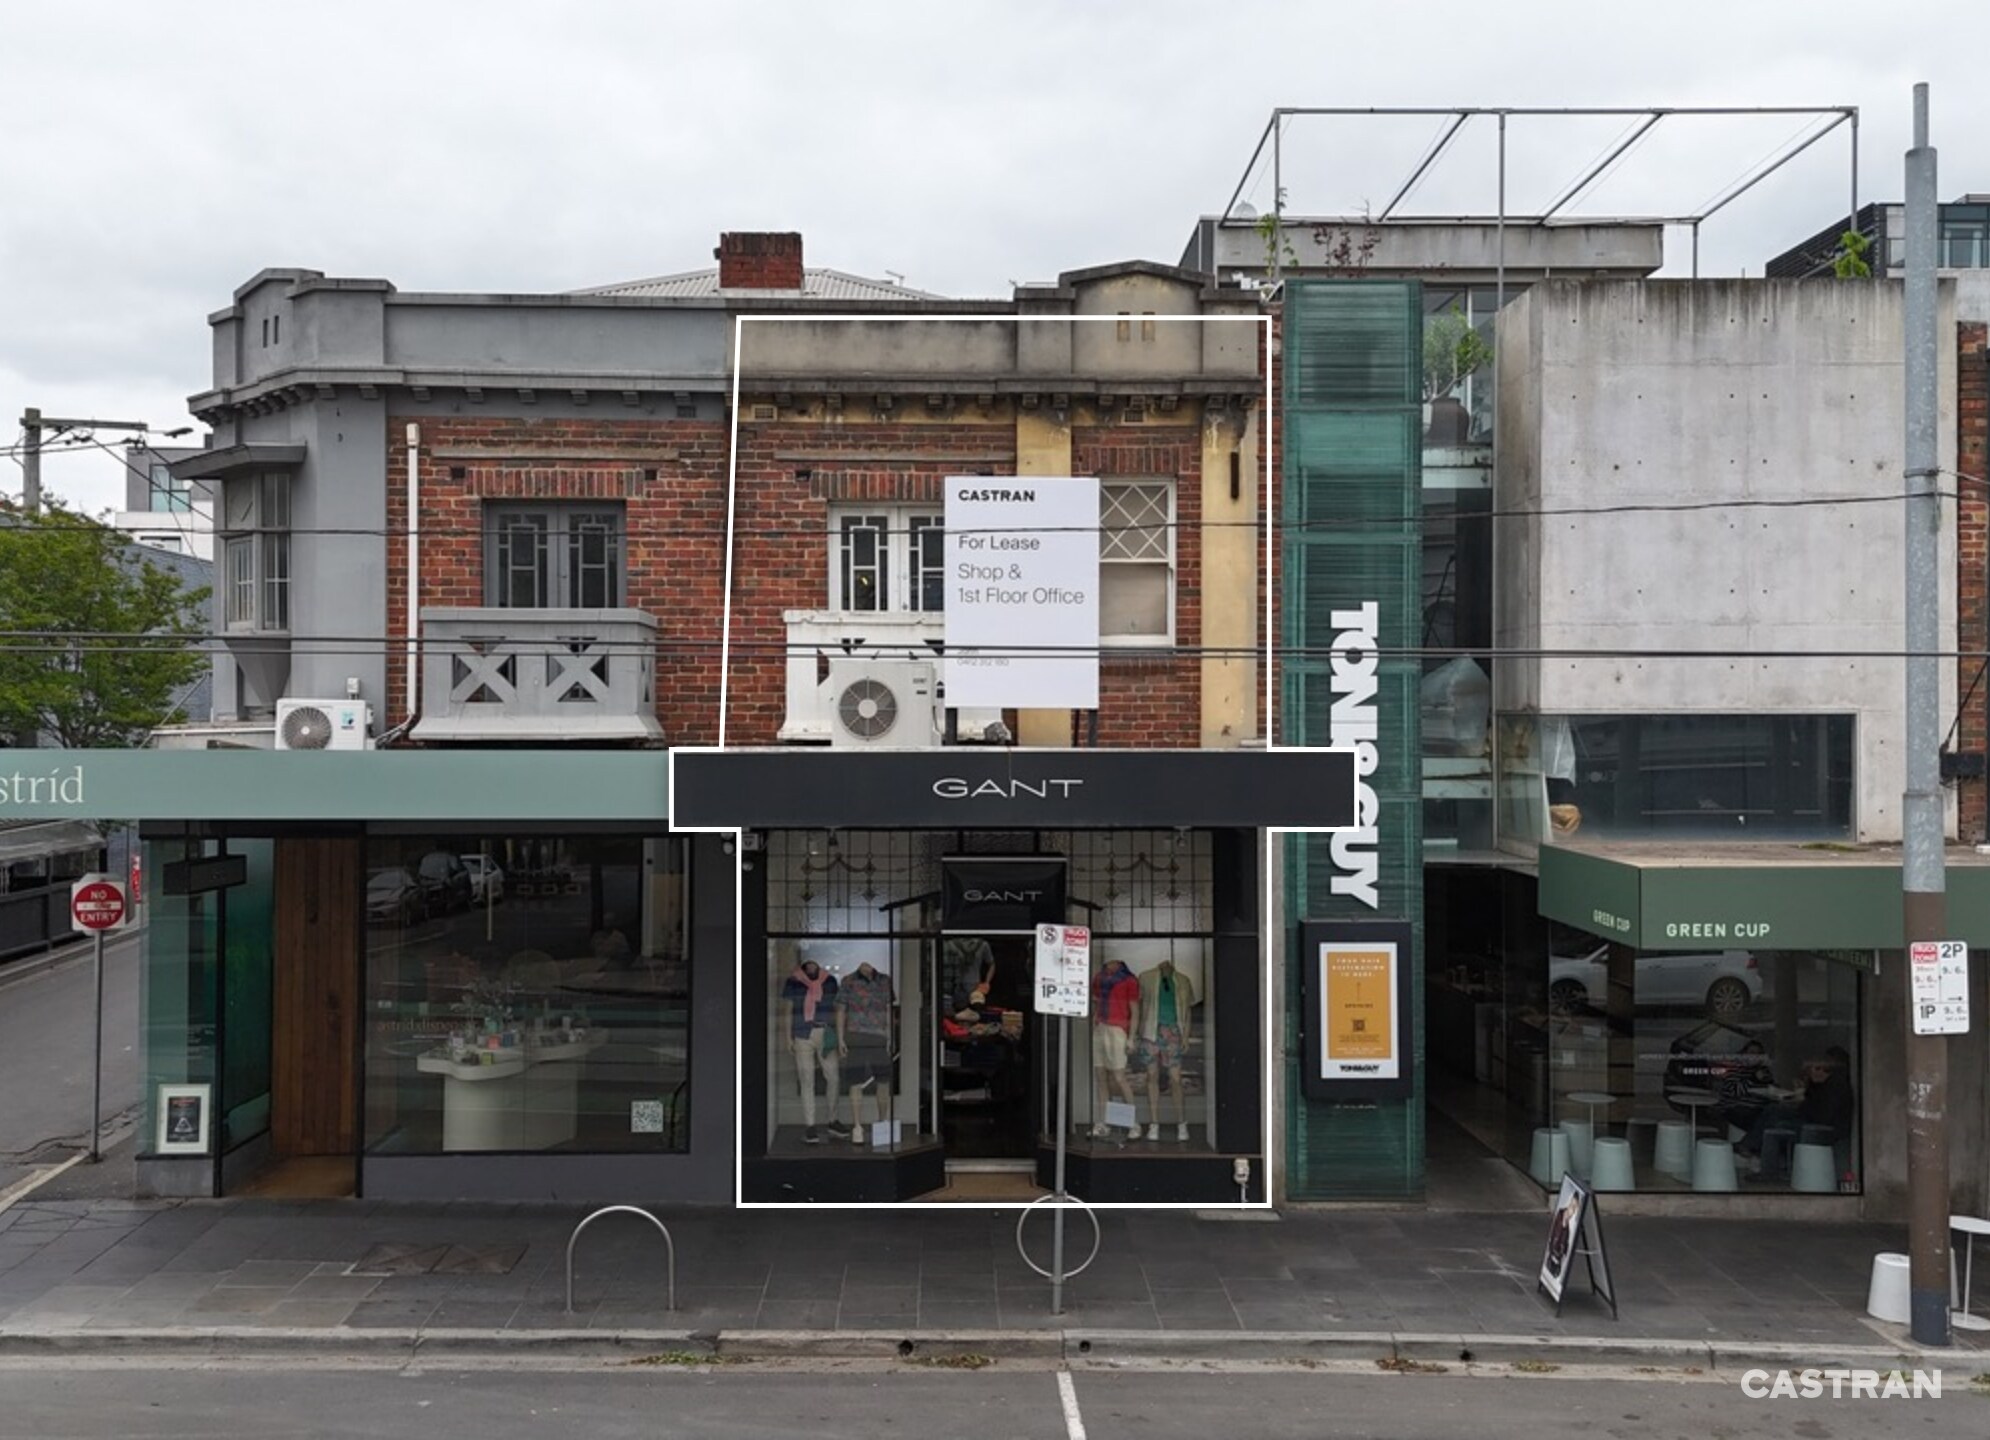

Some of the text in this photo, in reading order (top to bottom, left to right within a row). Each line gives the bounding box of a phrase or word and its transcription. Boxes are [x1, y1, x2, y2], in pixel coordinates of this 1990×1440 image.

[958, 489, 1035, 502] CASTRAN
[958, 535, 1040, 550] For Lease
[957, 563, 1022, 582] Shop &
[958, 587, 1085, 604] 1st Floor Office
[932, 778, 1084, 798] GANT
[90, 889, 108, 900] NO
[963, 890, 1043, 901] GANT
[80, 911, 117, 923] ENTRY
[1593, 909, 1631, 932] GREEN CUP
[1666, 923, 1771, 937] GREEN CUP
[1941, 944, 1963, 958] 2P
[1041, 984, 1057, 998] 1P
[1920, 1005, 1935, 1019] 1P
[1682, 1067, 1726, 1075] GREEN CUP
